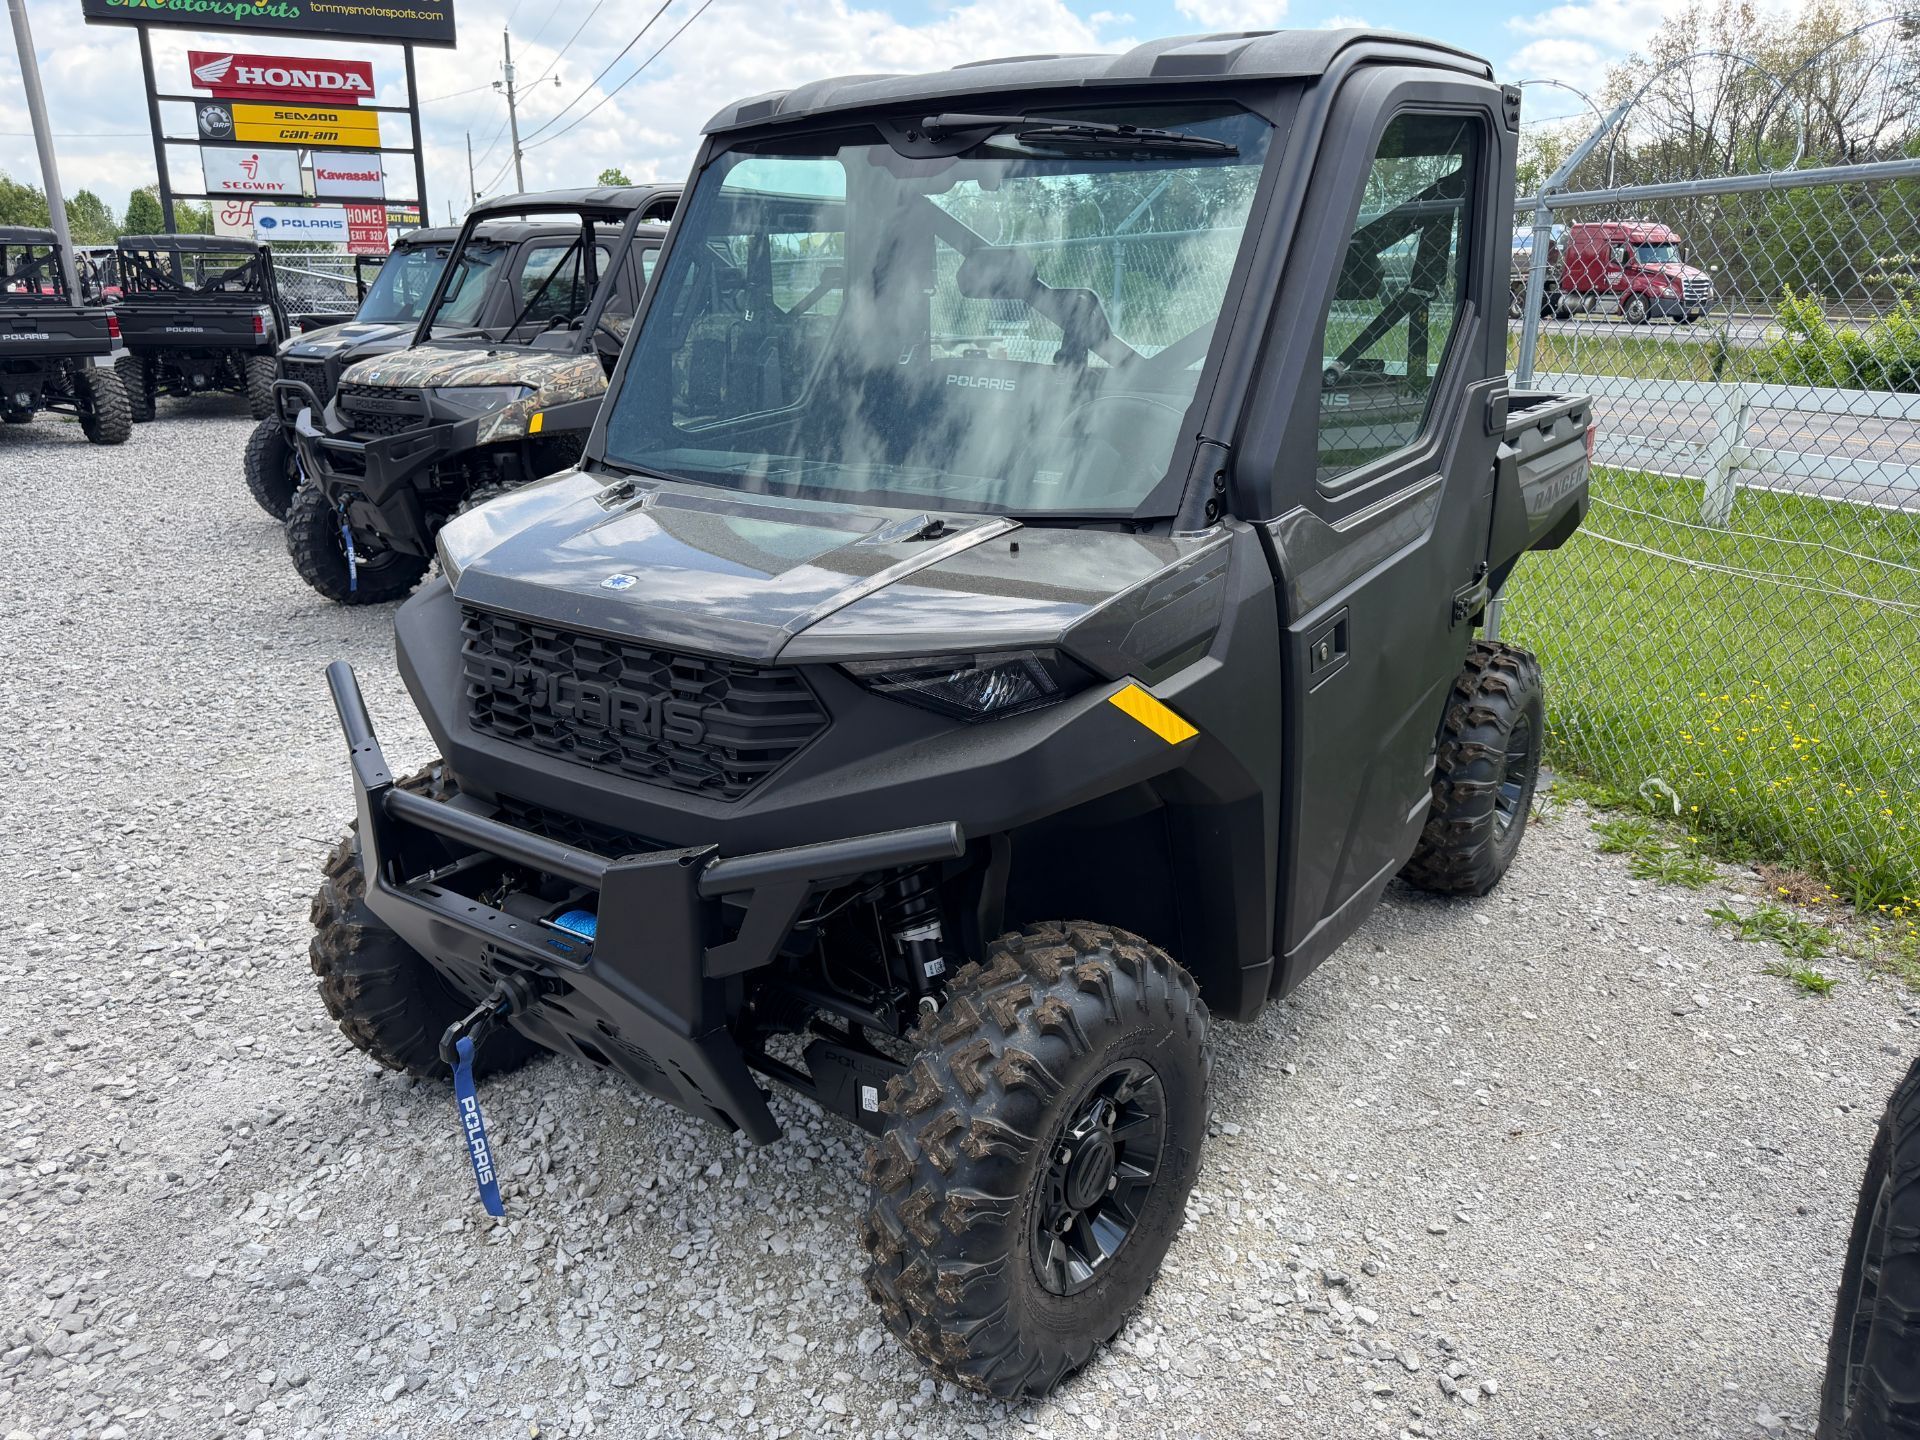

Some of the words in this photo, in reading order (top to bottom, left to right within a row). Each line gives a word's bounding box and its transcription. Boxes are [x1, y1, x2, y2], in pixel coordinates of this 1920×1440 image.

[310, 1, 443, 21] tommysmotorsports.com
[235, 66, 371, 91] HONDA
[212, 121, 230, 129] BRP
[279, 129, 338, 141] can-am
[316, 169, 380, 182] Kawasaki
[222, 181, 285, 191] SEGWAY
[281, 219, 343, 229] POLARIS
[347, 208, 382, 224] HOME!
[387, 214, 402, 222] EXIT
[403, 215, 420, 224] NOW
[351, 230, 366, 241] EXIT
[369, 231, 383, 241] 320
[551, 362, 597, 384] XP
[554, 375, 592, 392] 1000
[945, 374, 1016, 391] POLARIS
[356, 399, 394, 411] POLARIS
[1533, 465, 1584, 512] RANGER
[484, 655, 707, 745] POLARIS
[461, 1095, 494, 1185] POLARIS
